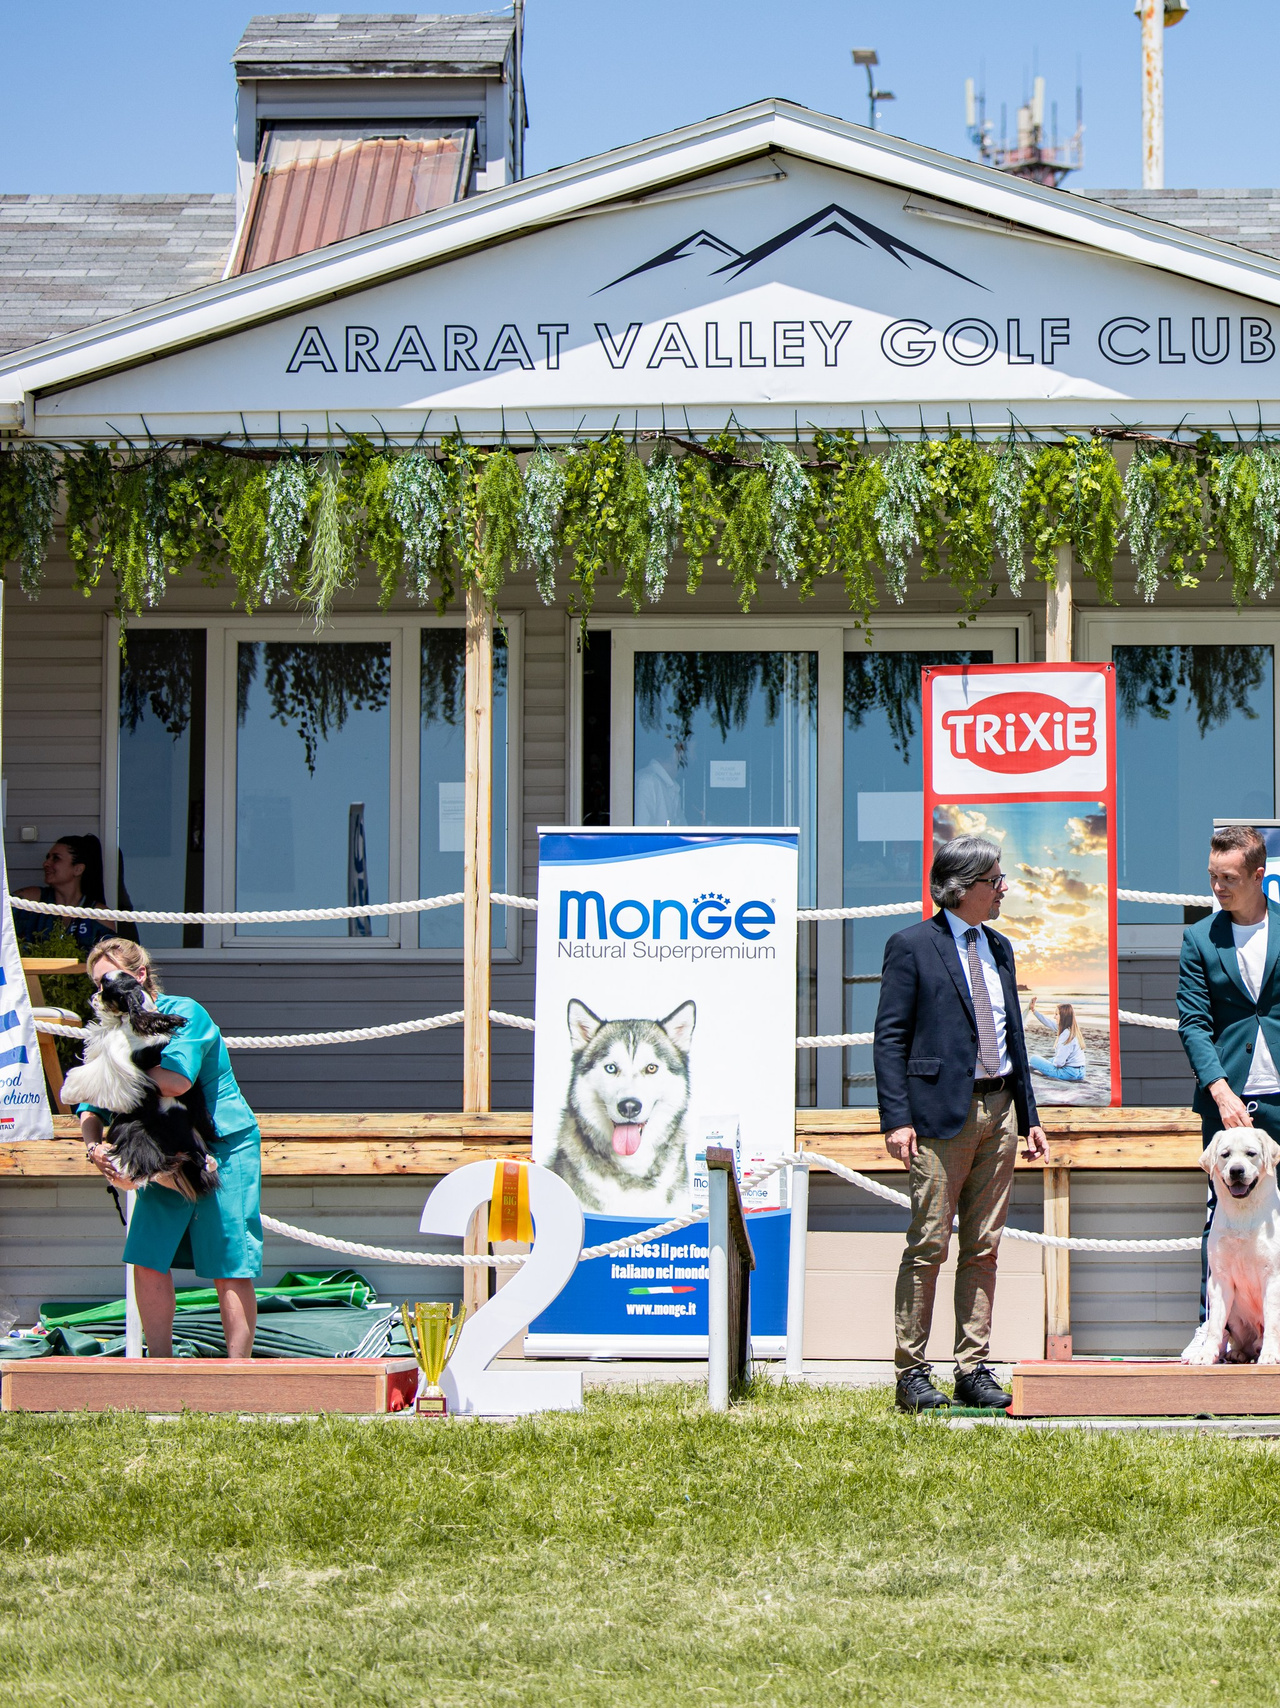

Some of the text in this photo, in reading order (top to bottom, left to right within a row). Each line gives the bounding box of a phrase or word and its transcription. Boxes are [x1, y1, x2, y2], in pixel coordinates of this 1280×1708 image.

[285, 316, 1276, 373] ARARAT VALLEY GOLF CLUB
[557, 941, 776, 962] Natural Superpremium
[3, 1089, 40, 1105] chiaro
[503, 1195, 517, 1206] BIG
[631, 1243, 660, 1258] 1963
[661, 1243, 669, 1258] il
[670, 1244, 689, 1261] pet
[611, 1264, 655, 1279] italiano
[656, 1264, 674, 1279] nel
[626, 1302, 697, 1318] www.monge.it
